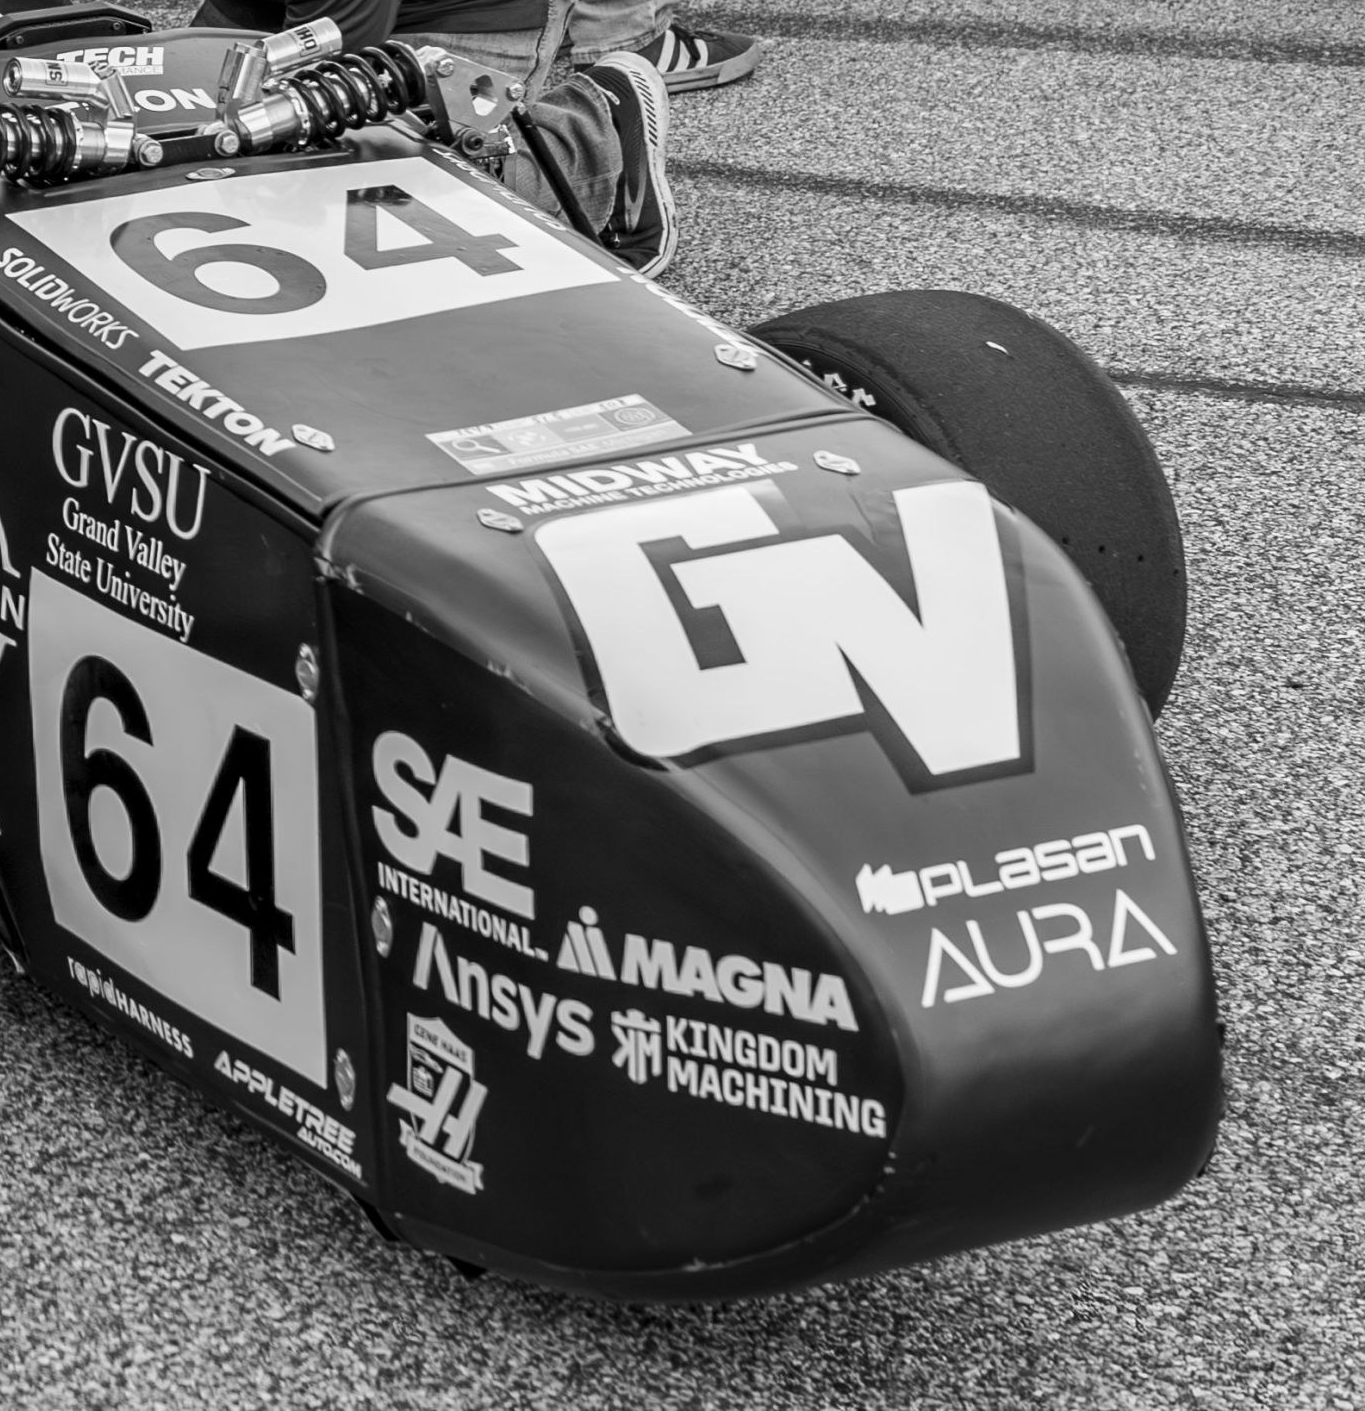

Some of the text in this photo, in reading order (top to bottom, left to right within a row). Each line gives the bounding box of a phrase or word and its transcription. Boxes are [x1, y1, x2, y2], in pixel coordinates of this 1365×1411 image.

[109, 183, 525, 316] 64
[137, 349, 298, 459] TEKTON
[52, 407, 212, 541] GVSU
[485, 443, 769, 507] MIDWAY
[520, 460, 800, 517] MACHINE TECHNOLOGIES
[45, 532, 196, 643] State University
[61, 497, 187, 591] Grand Valley
[58, 654, 297, 1004] 64
[371, 729, 535, 921] SAE
[378, 861, 537, 959] INTERNATIONAL
[921, 887, 1179, 1009] AURA
[66, 955, 195, 1060] rapidHARNESS
[413, 921, 596, 1060] Ansys
[620, 932, 860, 1033] MAGNA
[213, 1049, 358, 1155] APPLETREE
[665, 1014, 838, 1087] KINGDOM
[666, 1055, 888, 1139] MACHINING
